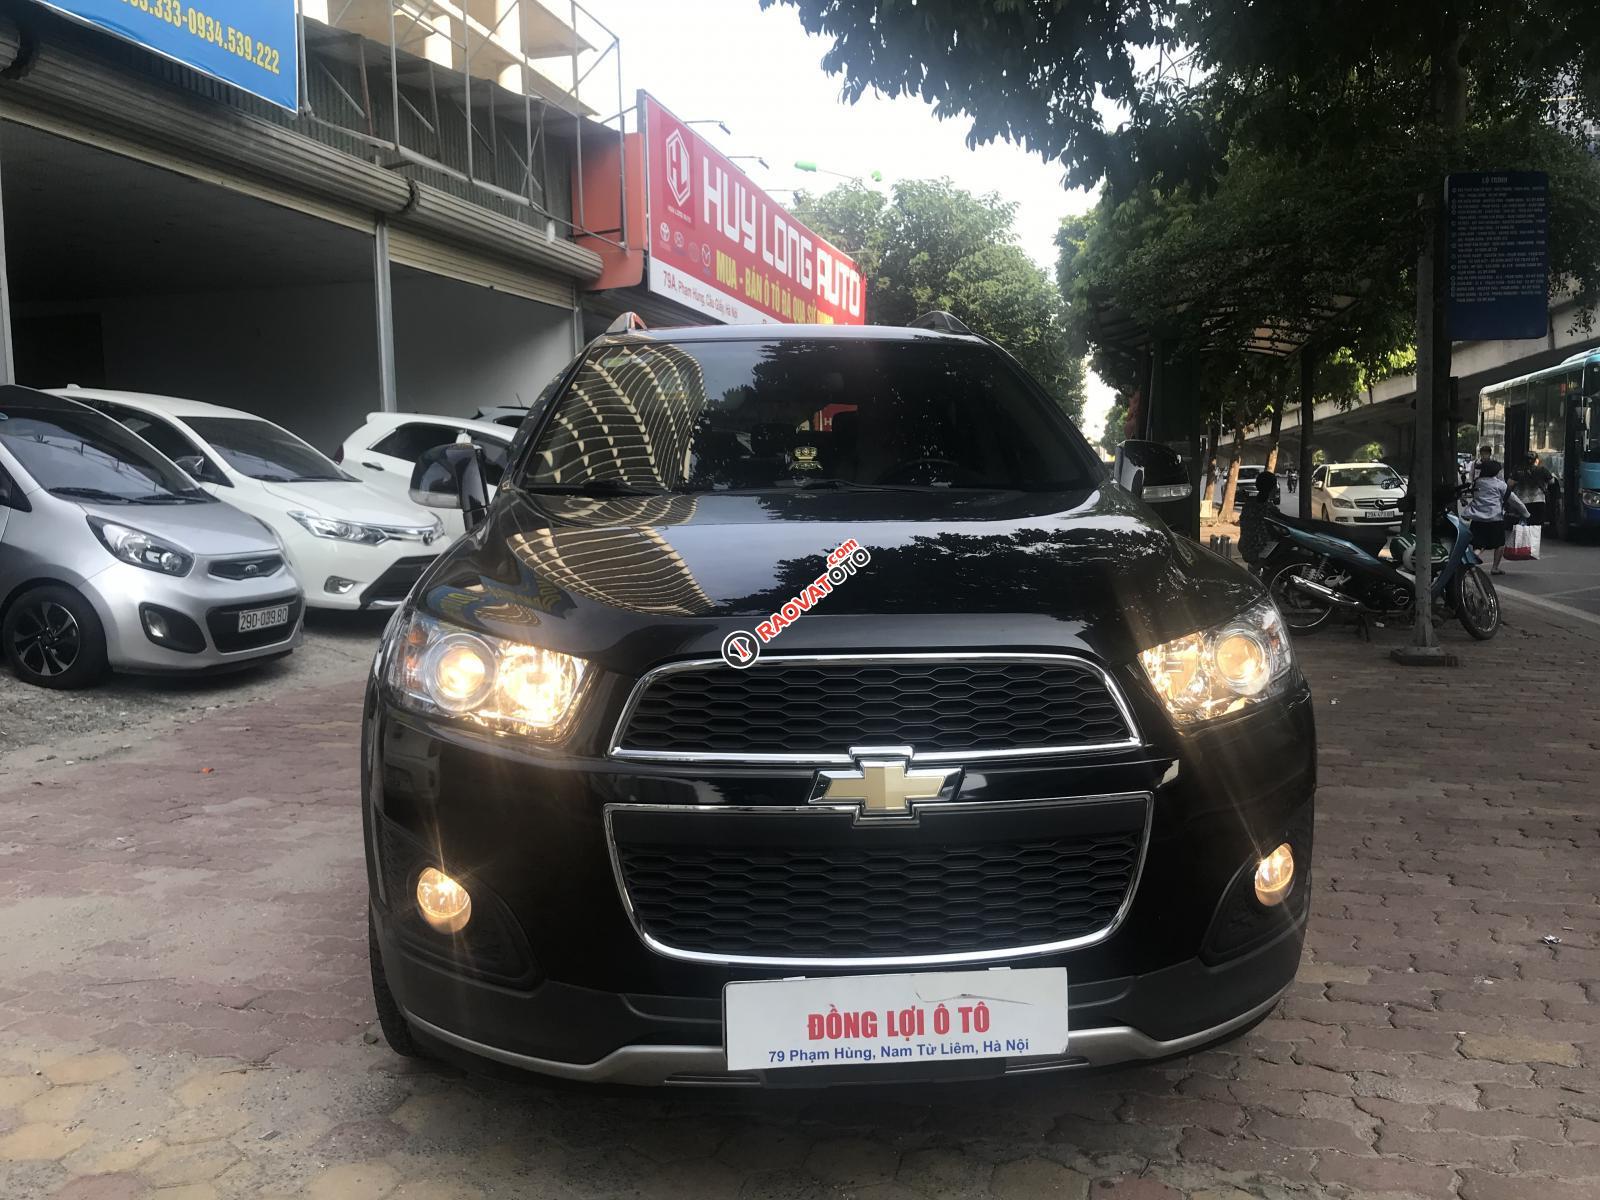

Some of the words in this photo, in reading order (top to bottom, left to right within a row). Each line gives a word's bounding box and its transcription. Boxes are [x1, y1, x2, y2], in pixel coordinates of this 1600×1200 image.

[703, 156, 756, 254] HUY
[762, 203, 813, 291] LONG
[816, 247, 860, 318] AUTO
[716, 249, 738, 291] MUA
[744, 265, 763, 304] BÁN
[763, 273, 770, 307] Ô
[771, 280, 780, 313] TÔ
[782, 287, 792, 319] ĐÃ
[807, 1003, 878, 1041] ĐỒNG
[886, 1005, 925, 1042] LỢI
[933, 1003, 950, 1036] Ô
[958, 1001, 990, 1034] TÔ
[768, 1050, 786, 1063] 79
[789, 1048, 830, 1064] Phạm
[834, 1046, 876, 1062] Hùng,
[880, 1044, 913, 1058] Nam
[916, 1042, 937, 1056] Từ
[940, 1040, 979, 1056] Liêm,
[983, 1038, 1001, 1052] Hà
[1006, 1037, 1030, 1051] Nội
